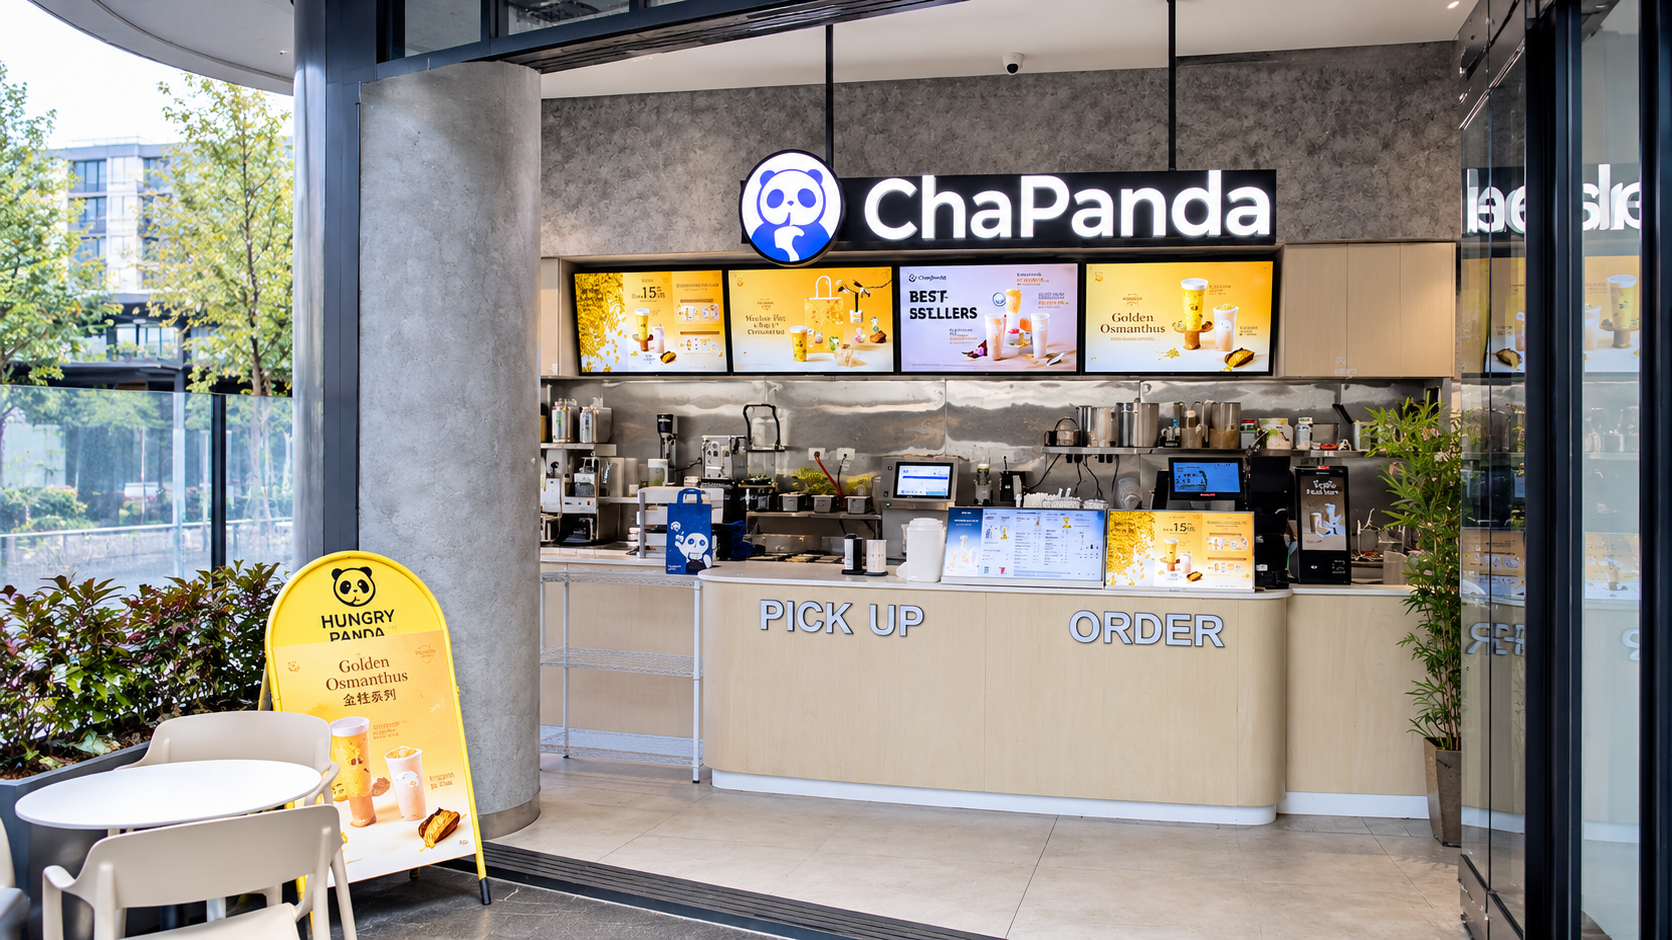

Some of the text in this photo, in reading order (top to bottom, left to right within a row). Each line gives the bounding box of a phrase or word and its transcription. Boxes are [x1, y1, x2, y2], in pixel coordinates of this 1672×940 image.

[864, 170, 1270, 240] ChaPanda
[1111, 312, 1155, 323] Golden
[1100, 323, 1166, 334] Osmanthus
[321, 609, 395, 629] HUNGRY
[760, 599, 925, 637] PICK UP
[1069, 610, 1226, 648] ORDER
[338, 656, 390, 674] Golden
[325, 672, 408, 691] Osmanthus
